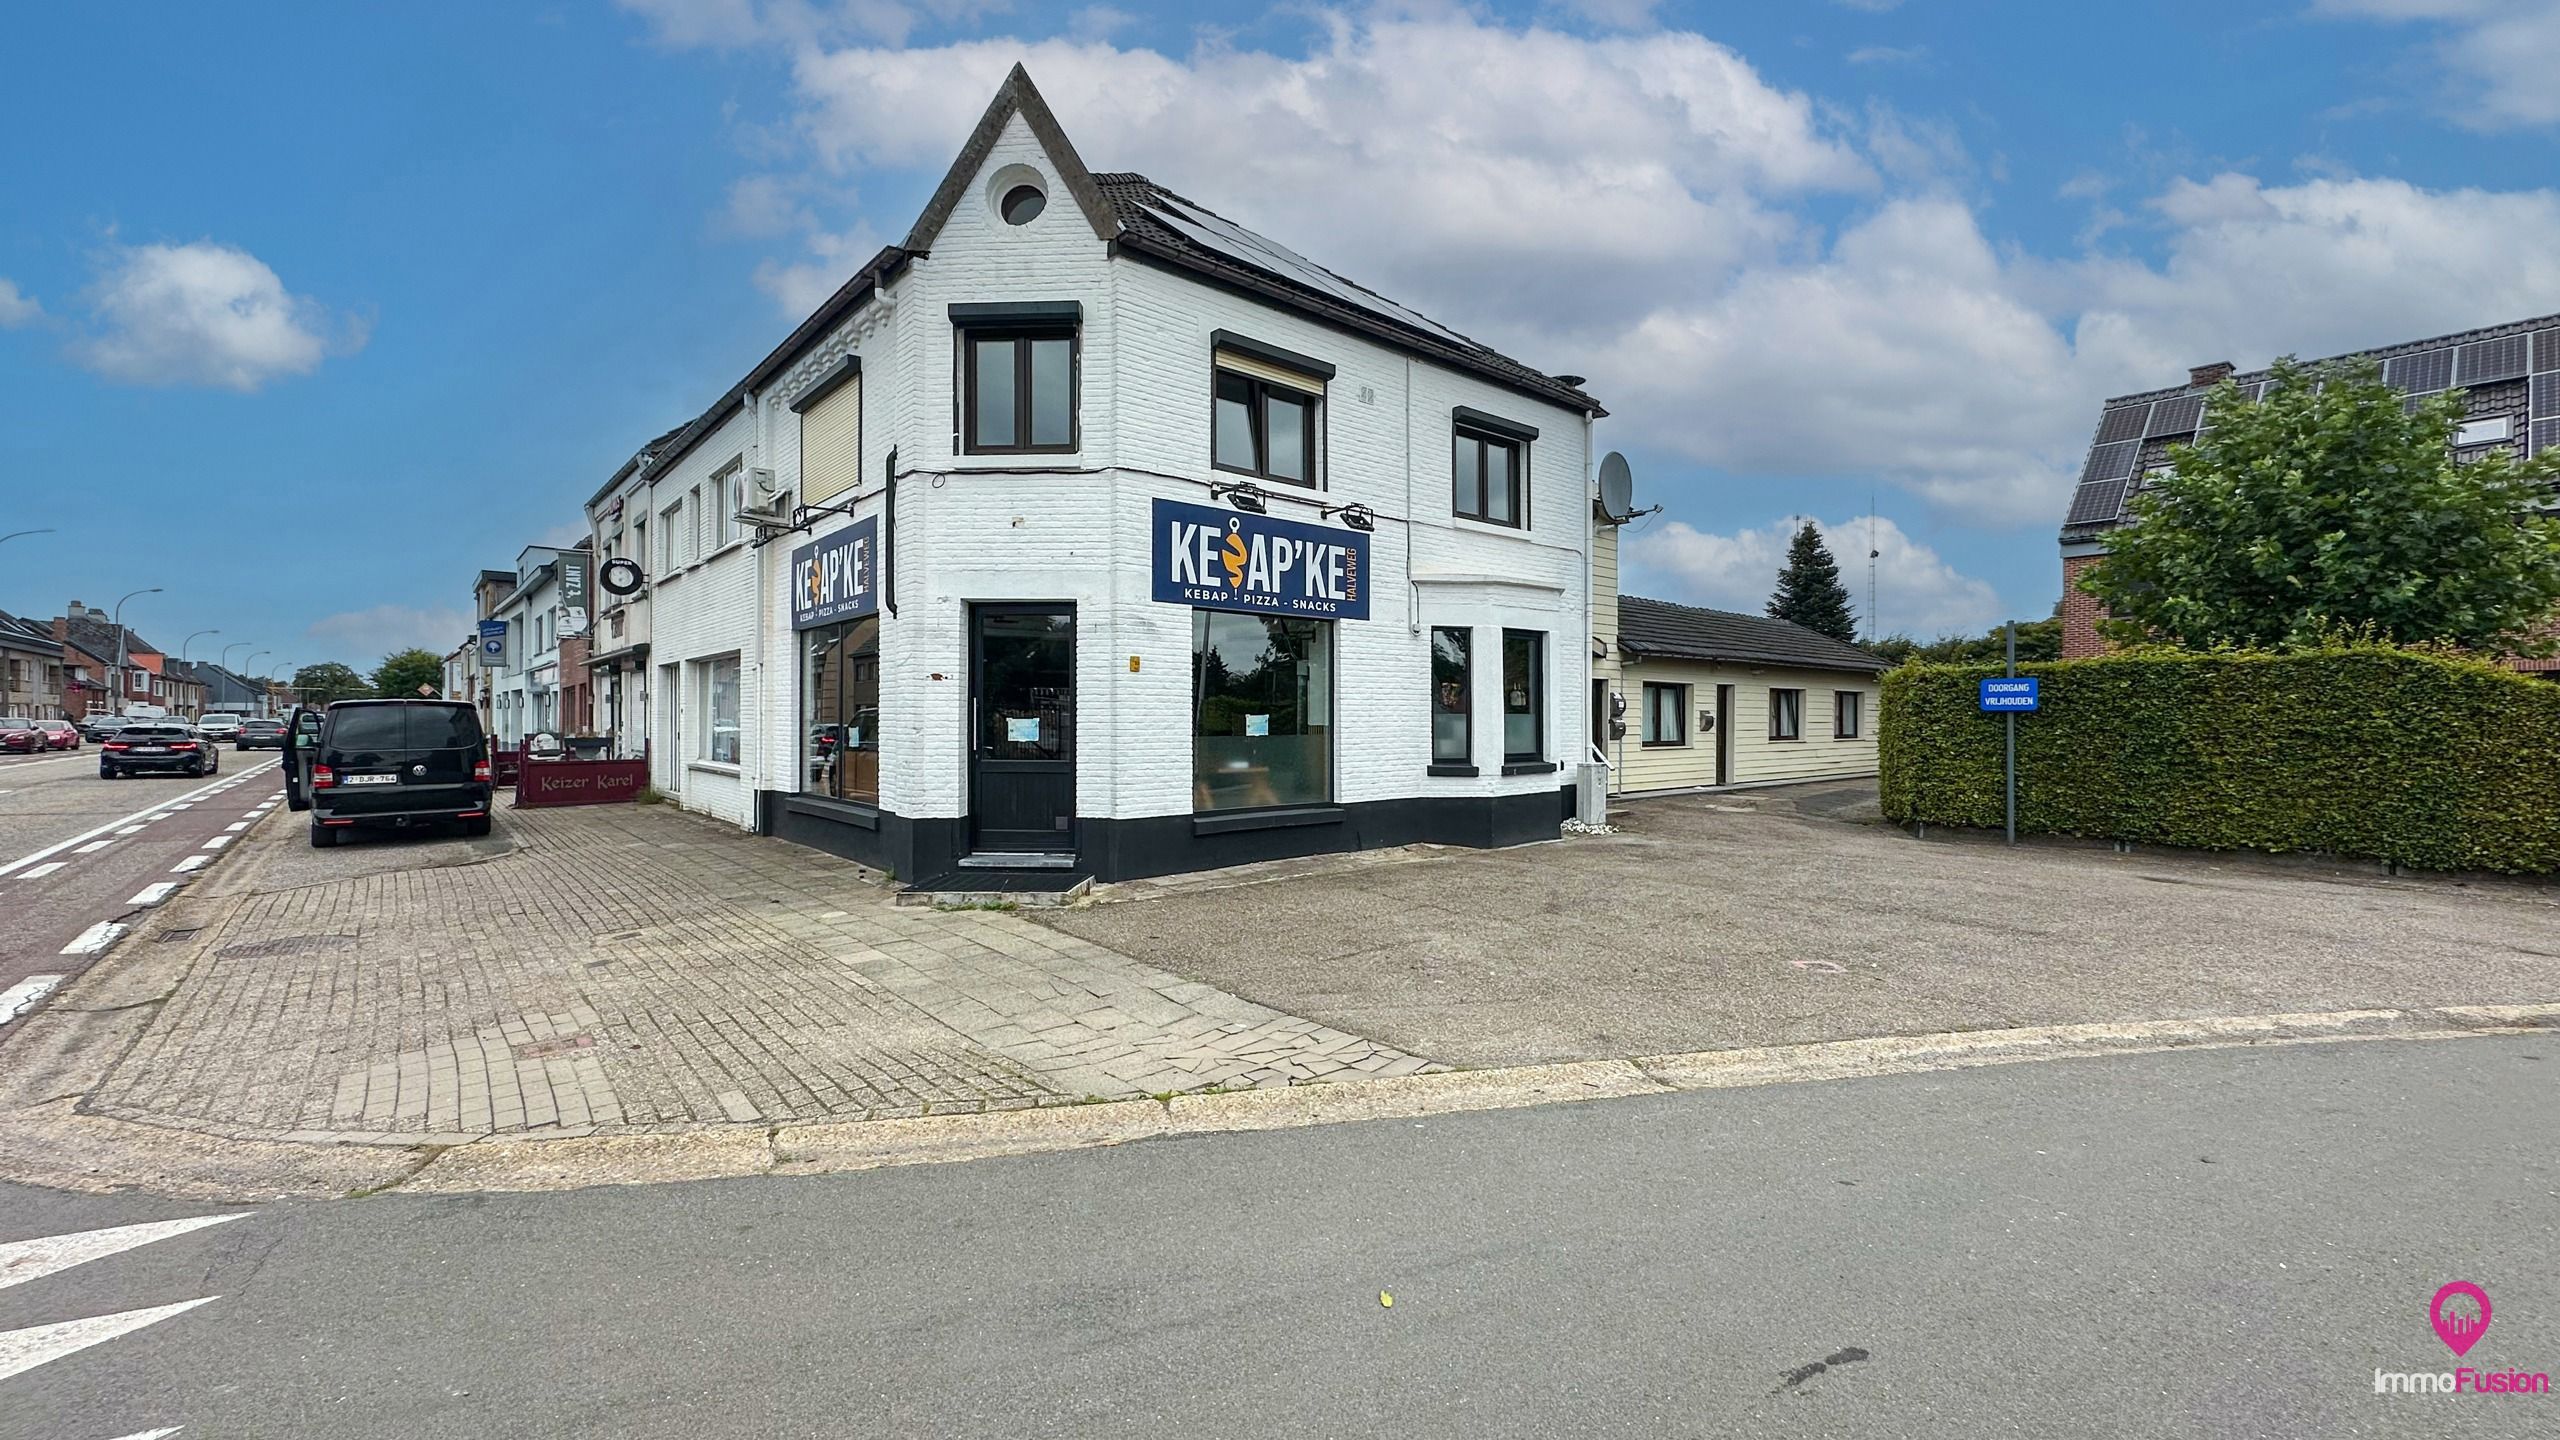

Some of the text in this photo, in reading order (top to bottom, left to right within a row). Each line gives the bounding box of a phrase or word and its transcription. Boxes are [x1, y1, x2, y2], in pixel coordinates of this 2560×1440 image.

[566, 565, 582, 588] ZANT
[1346, 548, 1357, 602] HALVEWEG
[800, 600, 859, 622] KEBAP PIZZA SNACKS
[1184, 588, 1229, 601] KEBAP
[1243, 594, 1279, 607] PIZZA
[1292, 600, 1336, 613] SNACKS
[1988, 683, 2030, 692] DOORGANG
[1984, 697, 2034, 706] VRIJHOUDEN
[541, 774, 633, 792] Keizer Karel
